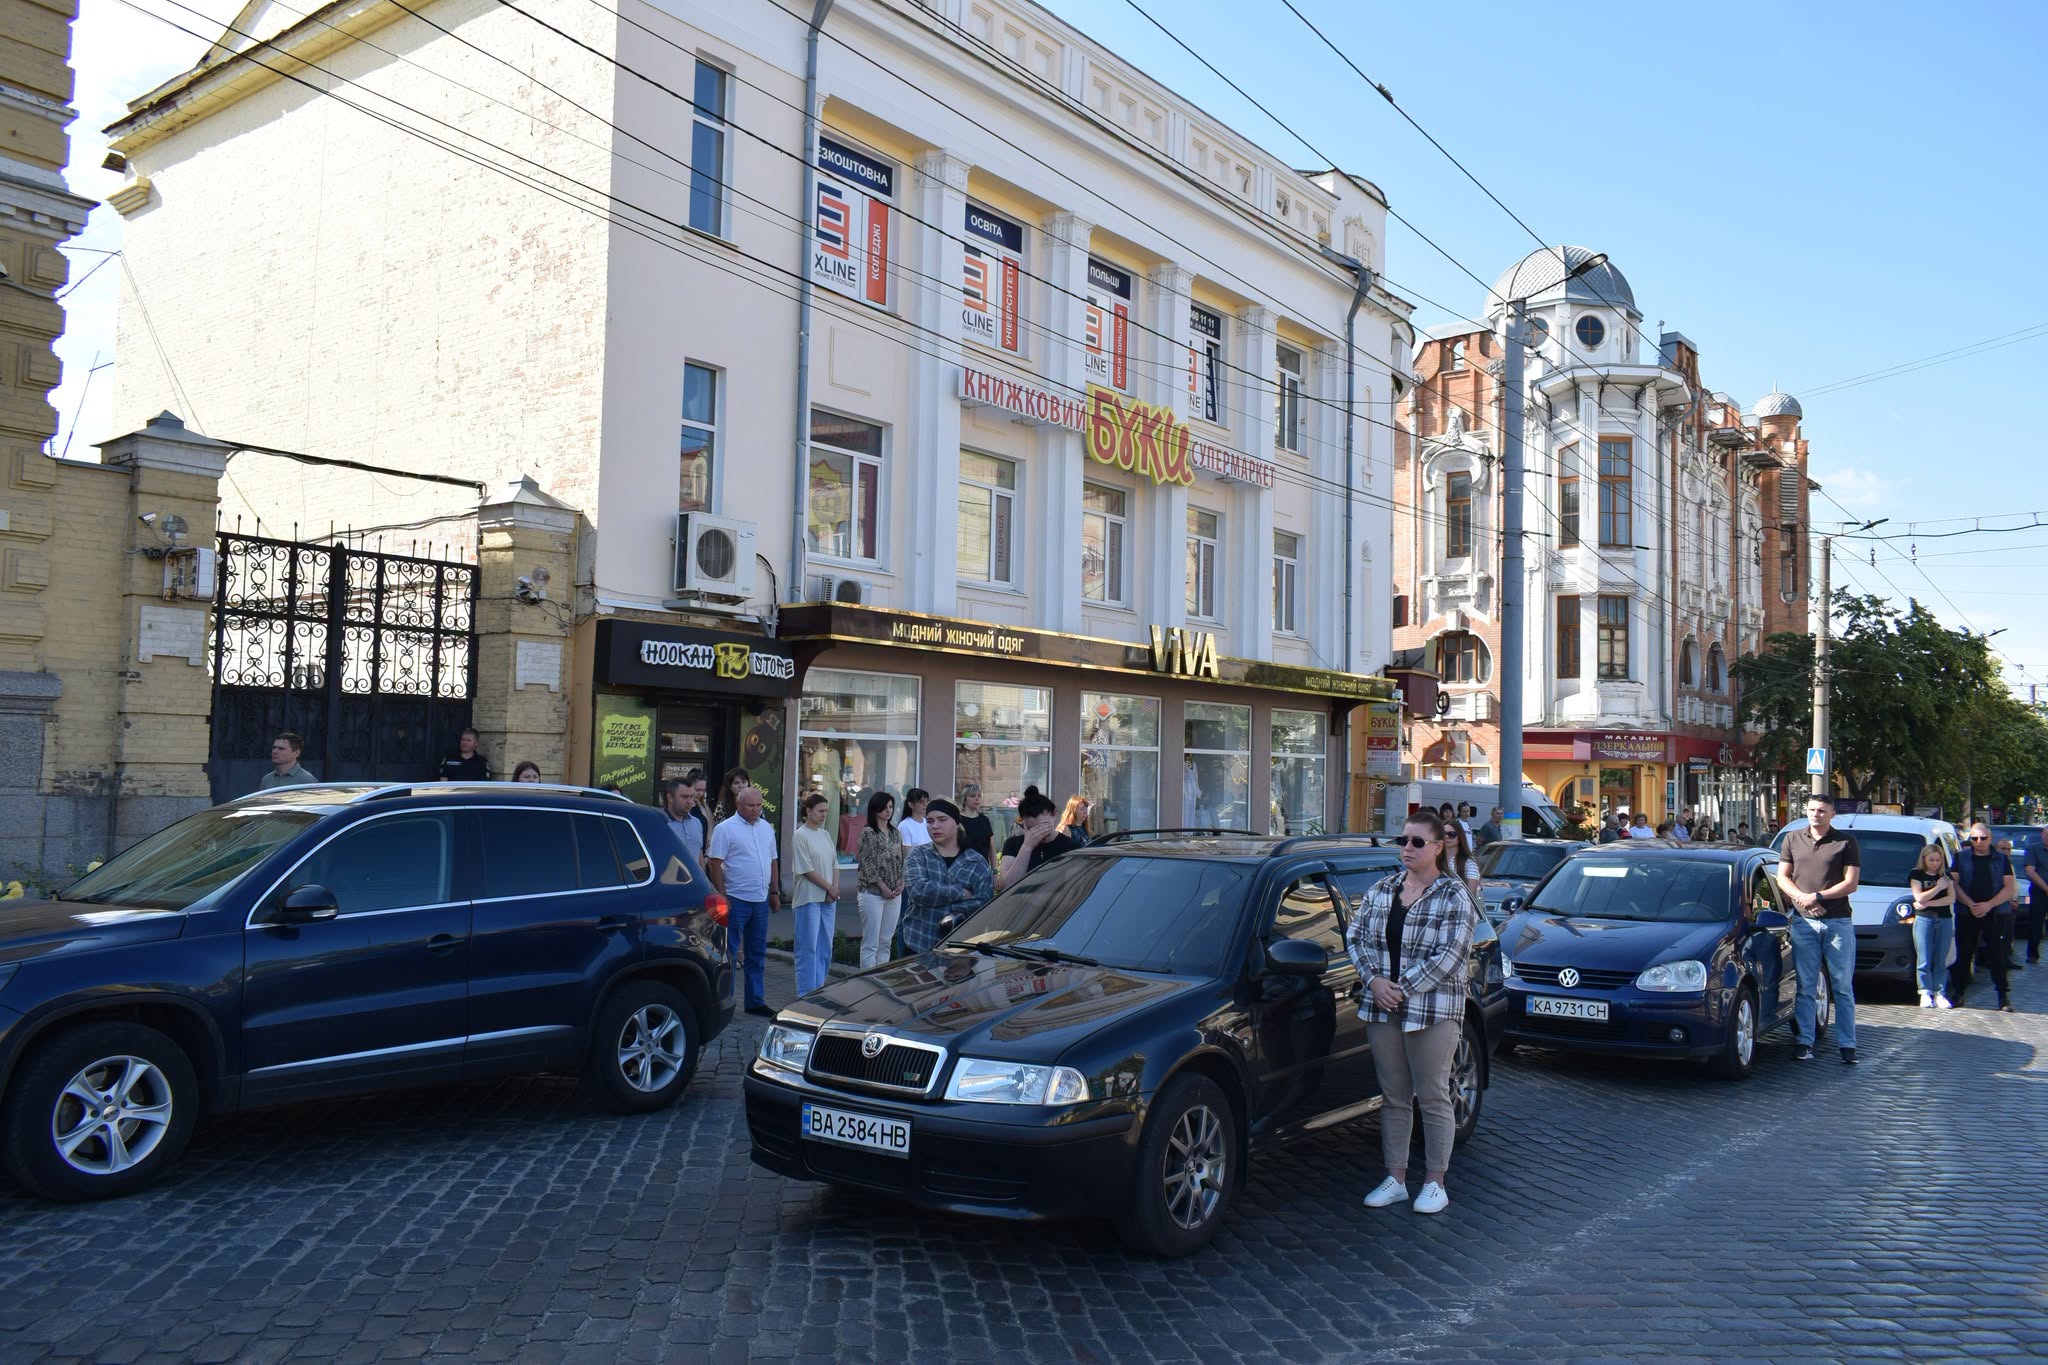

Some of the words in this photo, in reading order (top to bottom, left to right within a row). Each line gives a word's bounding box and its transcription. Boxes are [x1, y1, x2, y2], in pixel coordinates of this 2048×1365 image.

[970, 214, 1003, 238] ОСВІТА
[871, 223, 881, 280] КОЛЕДЖІ
[1090, 265, 1120, 289] ПОЛЬЩІ
[963, 367, 1087, 433] КНИЖКОВИЙ
[1088, 386, 1195, 486] БУКИ
[1190, 439, 1276, 489] СУПЕРМАРКЕТ
[892, 621, 942, 643] МОДНИЙ
[945, 629, 995, 649] ЖІНОЧИЙ
[997, 635, 1025, 654] ОДЯГ
[642, 640, 715, 668] HOOKAH
[716, 643, 750, 679] 13
[753, 652, 794, 679] STORE
[611, 722, 624, 730] ТУТ
[1370, 717, 1396, 729] БУКИ
[1592, 740, 1665, 752] ДЗЕРКАЛЬНИЙ
[1534, 1000, 1552, 1013] KA
[1554, 1002, 1584, 1016] 9731
[1587, 1004, 1607, 1018] CH
[811, 1110, 834, 1135] BA
[837, 1116, 877, 1144] 2584
[880, 1123, 907, 1148] HB
